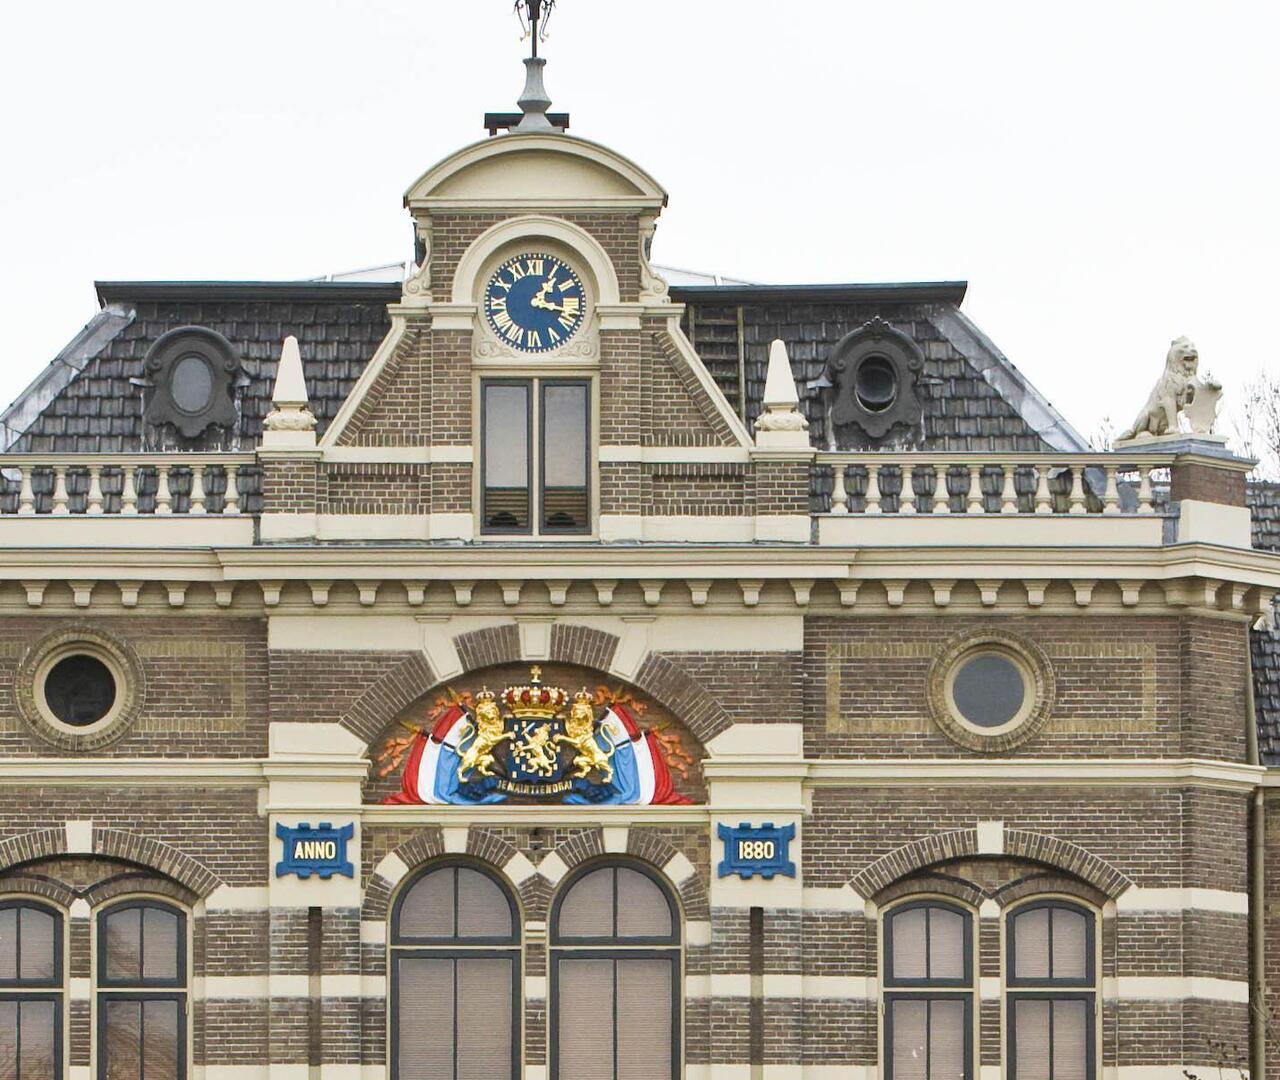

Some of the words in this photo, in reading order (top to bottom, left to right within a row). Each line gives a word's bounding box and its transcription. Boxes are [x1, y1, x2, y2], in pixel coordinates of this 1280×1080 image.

[507, 262, 526, 282] XI
[526, 260, 544, 276] XII
[494, 277, 512, 293] X
[557, 279, 575, 292] II
[491, 296, 507, 310] IX
[527, 330, 542, 347] VI
[548, 327, 561, 344] V
[294, 841, 336, 860] ANNO
[739, 841, 775, 860] 1880
